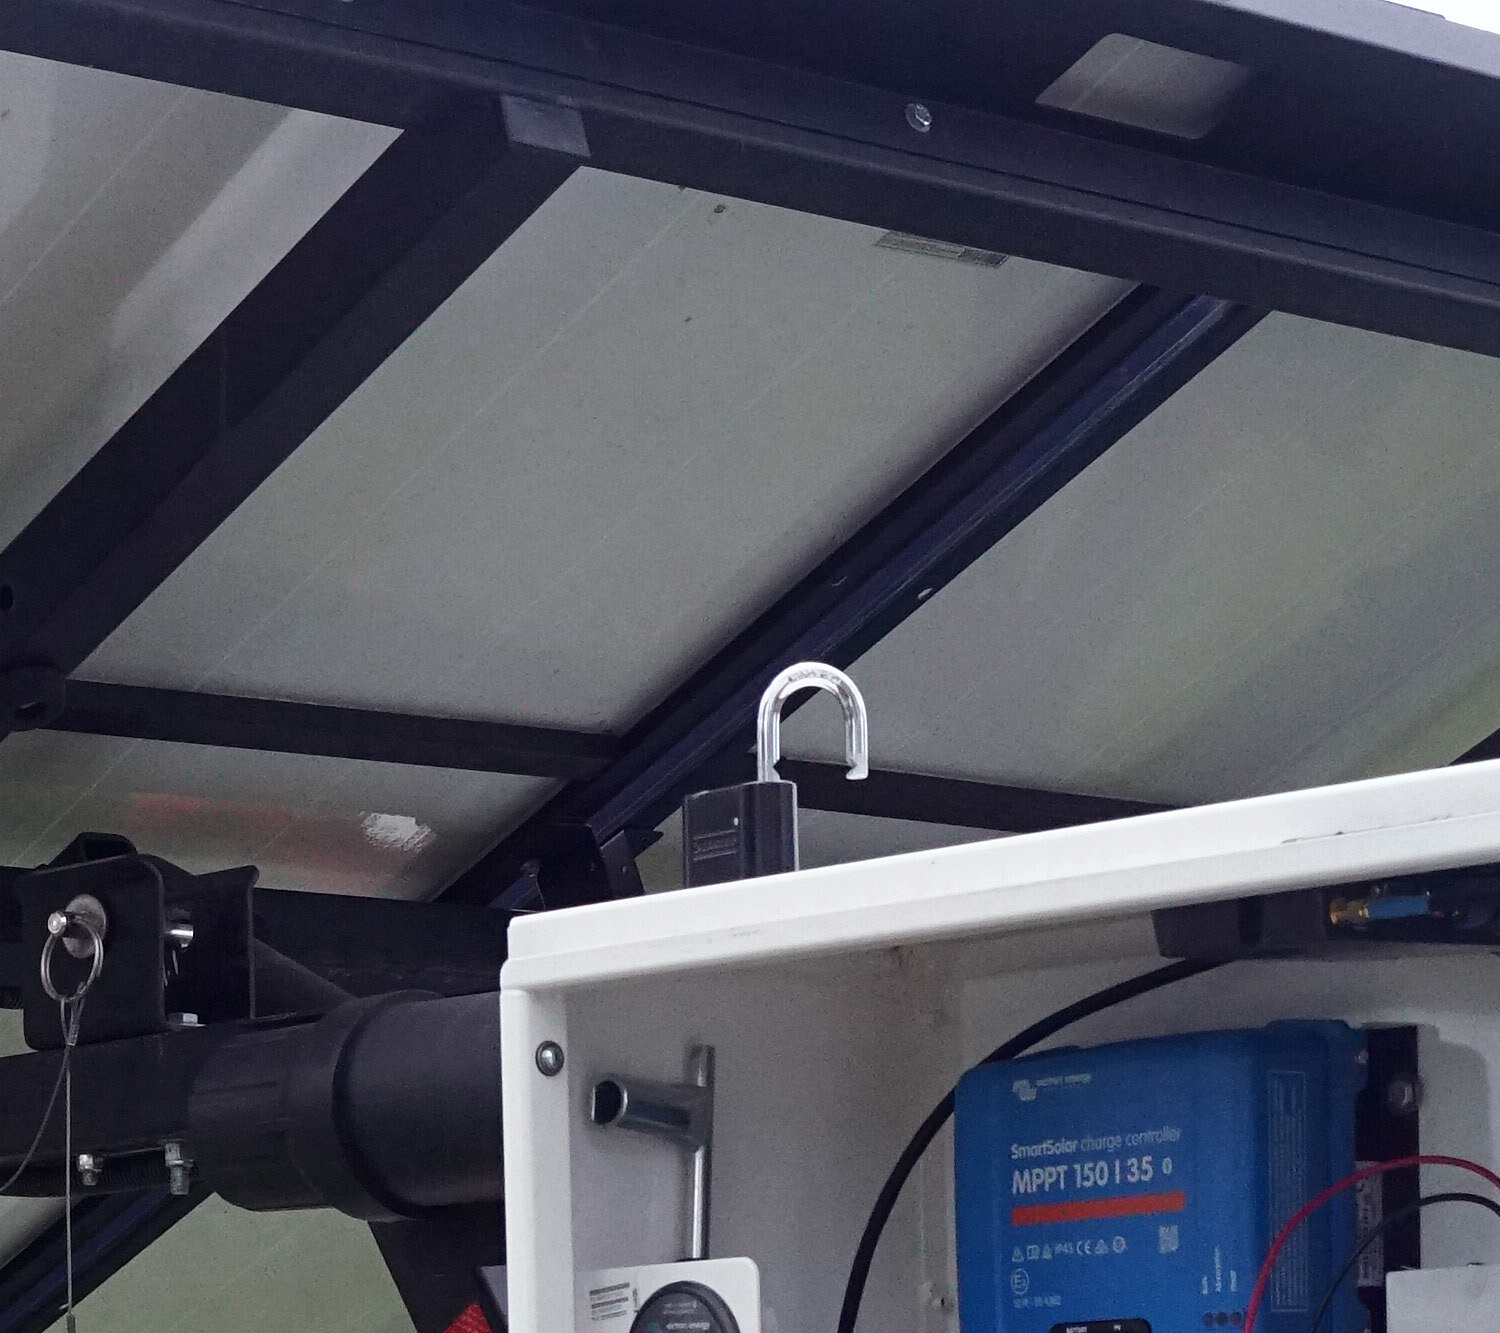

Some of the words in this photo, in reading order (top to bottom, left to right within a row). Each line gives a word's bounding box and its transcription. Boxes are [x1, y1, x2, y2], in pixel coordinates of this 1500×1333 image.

[1011, 1138, 1078, 1160] SmartSolar
[1080, 1134, 1122, 1153] charge
[1125, 1126, 1182, 1146] controller
[1012, 1165, 1068, 1195] MPPT
[1074, 1161, 1109, 1188] 150
[1127, 1156, 1153, 1183] 35
